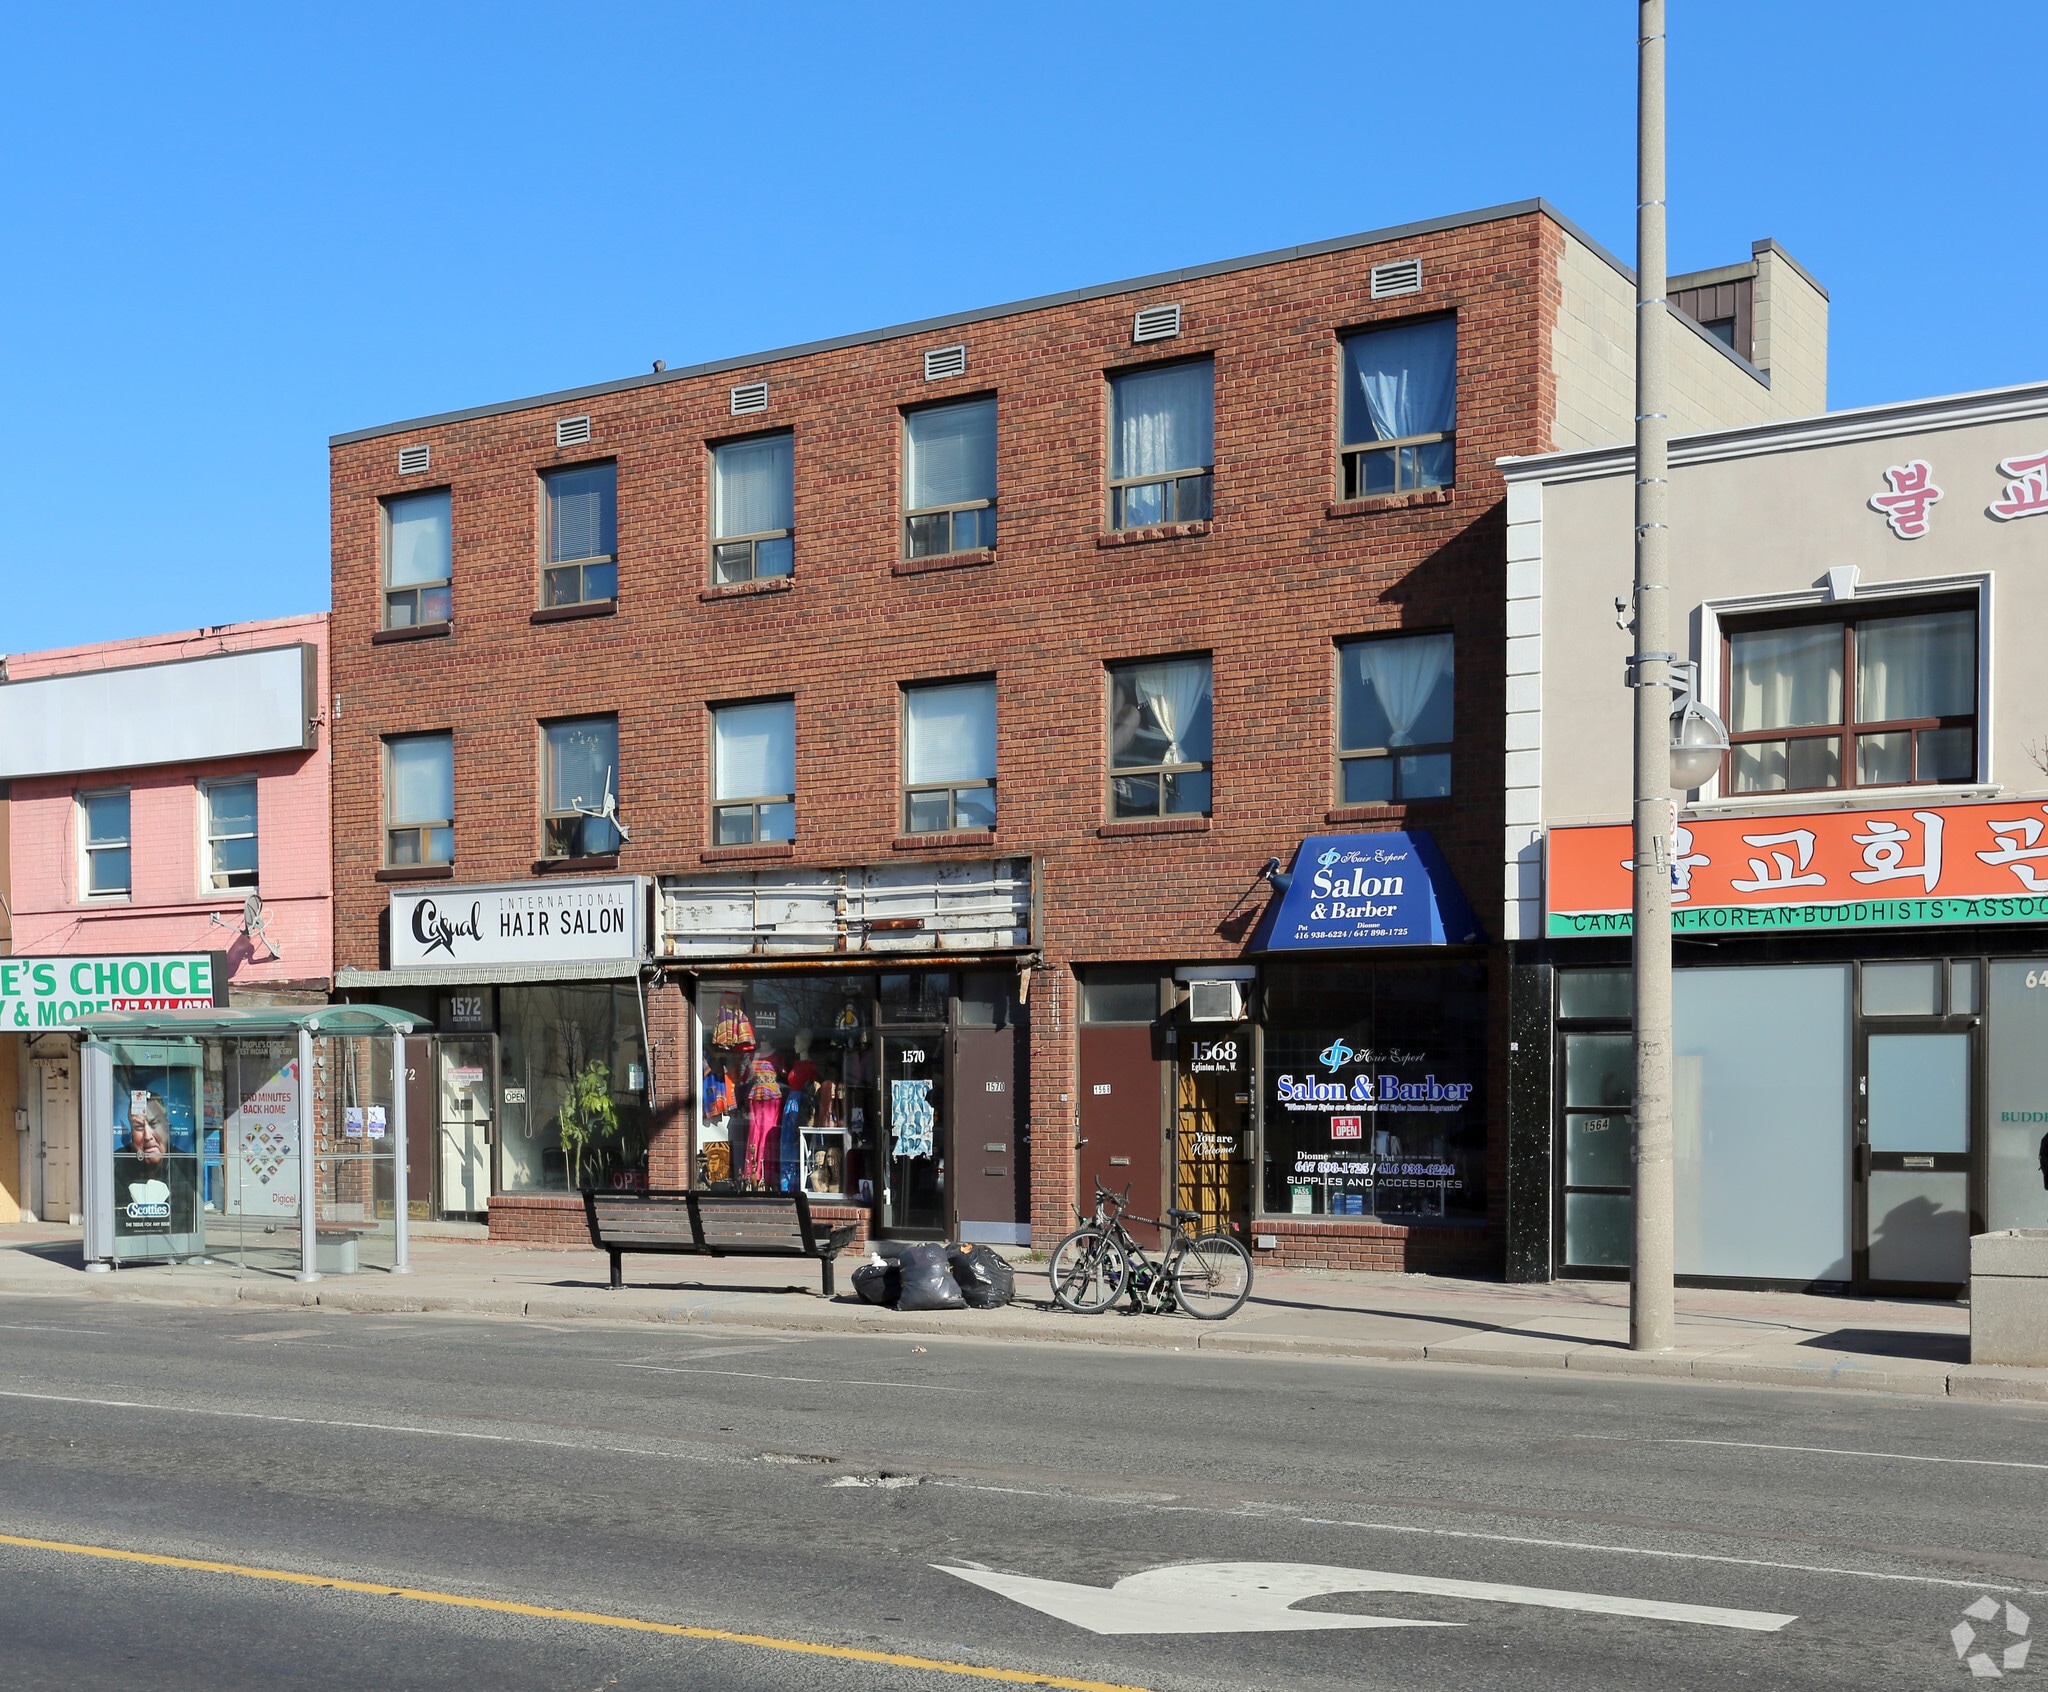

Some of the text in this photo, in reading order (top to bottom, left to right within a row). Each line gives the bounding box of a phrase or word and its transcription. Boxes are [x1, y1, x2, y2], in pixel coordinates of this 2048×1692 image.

[1341, 851, 1371, 863] Hair
[1373, 849, 1408, 865] Expert
[1310, 868, 1404, 899] Salon
[500, 893, 624, 910] INTERNATIONAL
[1310, 901, 1397, 920] & Barber
[412, 899, 484, 952] Casual
[500, 908, 624, 937] HAIR SALON
[1311, 930, 1348, 939] 938-6224
[1354, 930, 1368, 938] 647
[1370, 928, 1408, 936] 898-1725
[70, 961, 212, 996] CHOICE
[451, 997, 481, 1016] 1572
[14, 1001, 30, 1026] &
[902, 1050, 925, 1063] 1570
[1191, 1041, 1238, 1061] 1568
[1354, 1048, 1386, 1063] Hair
[1389, 1048, 1426, 1066] Expert
[1192, 1062, 1214, 1073] Eglinton
[987, 1082, 1005, 1091] 1570
[1278, 1074, 1347, 1101] Salon
[1350, 1074, 1374, 1101] &
[1378, 1074, 1472, 1101] Barber
[258, 1093, 291, 1102] MINUTES
[506, 1093, 525, 1102] OPEN
[244, 1105, 286, 1114] BACK HOME
[1336, 1126, 1357, 1136] OPEN
[1584, 1119, 1608, 1132] 1564
[1195, 1132, 1215, 1143] You
[1191, 1143, 1237, 1156] Welcome!
[1297, 1151, 1328, 1160] Dionne
[1380, 1153, 1395, 1162] Pat
[1295, 1161, 1316, 1173] 647
[1318, 1162, 1370, 1174] 898-1725
[1378, 1164, 1400, 1175] 416
[1402, 1164, 1455, 1176] 938-6224
[1287, 1176, 1463, 1189] SUPPLIES AND ACCESSORIES
[272, 1193, 296, 1205] Digicel
[130, 1204, 167, 1217] Scotties
